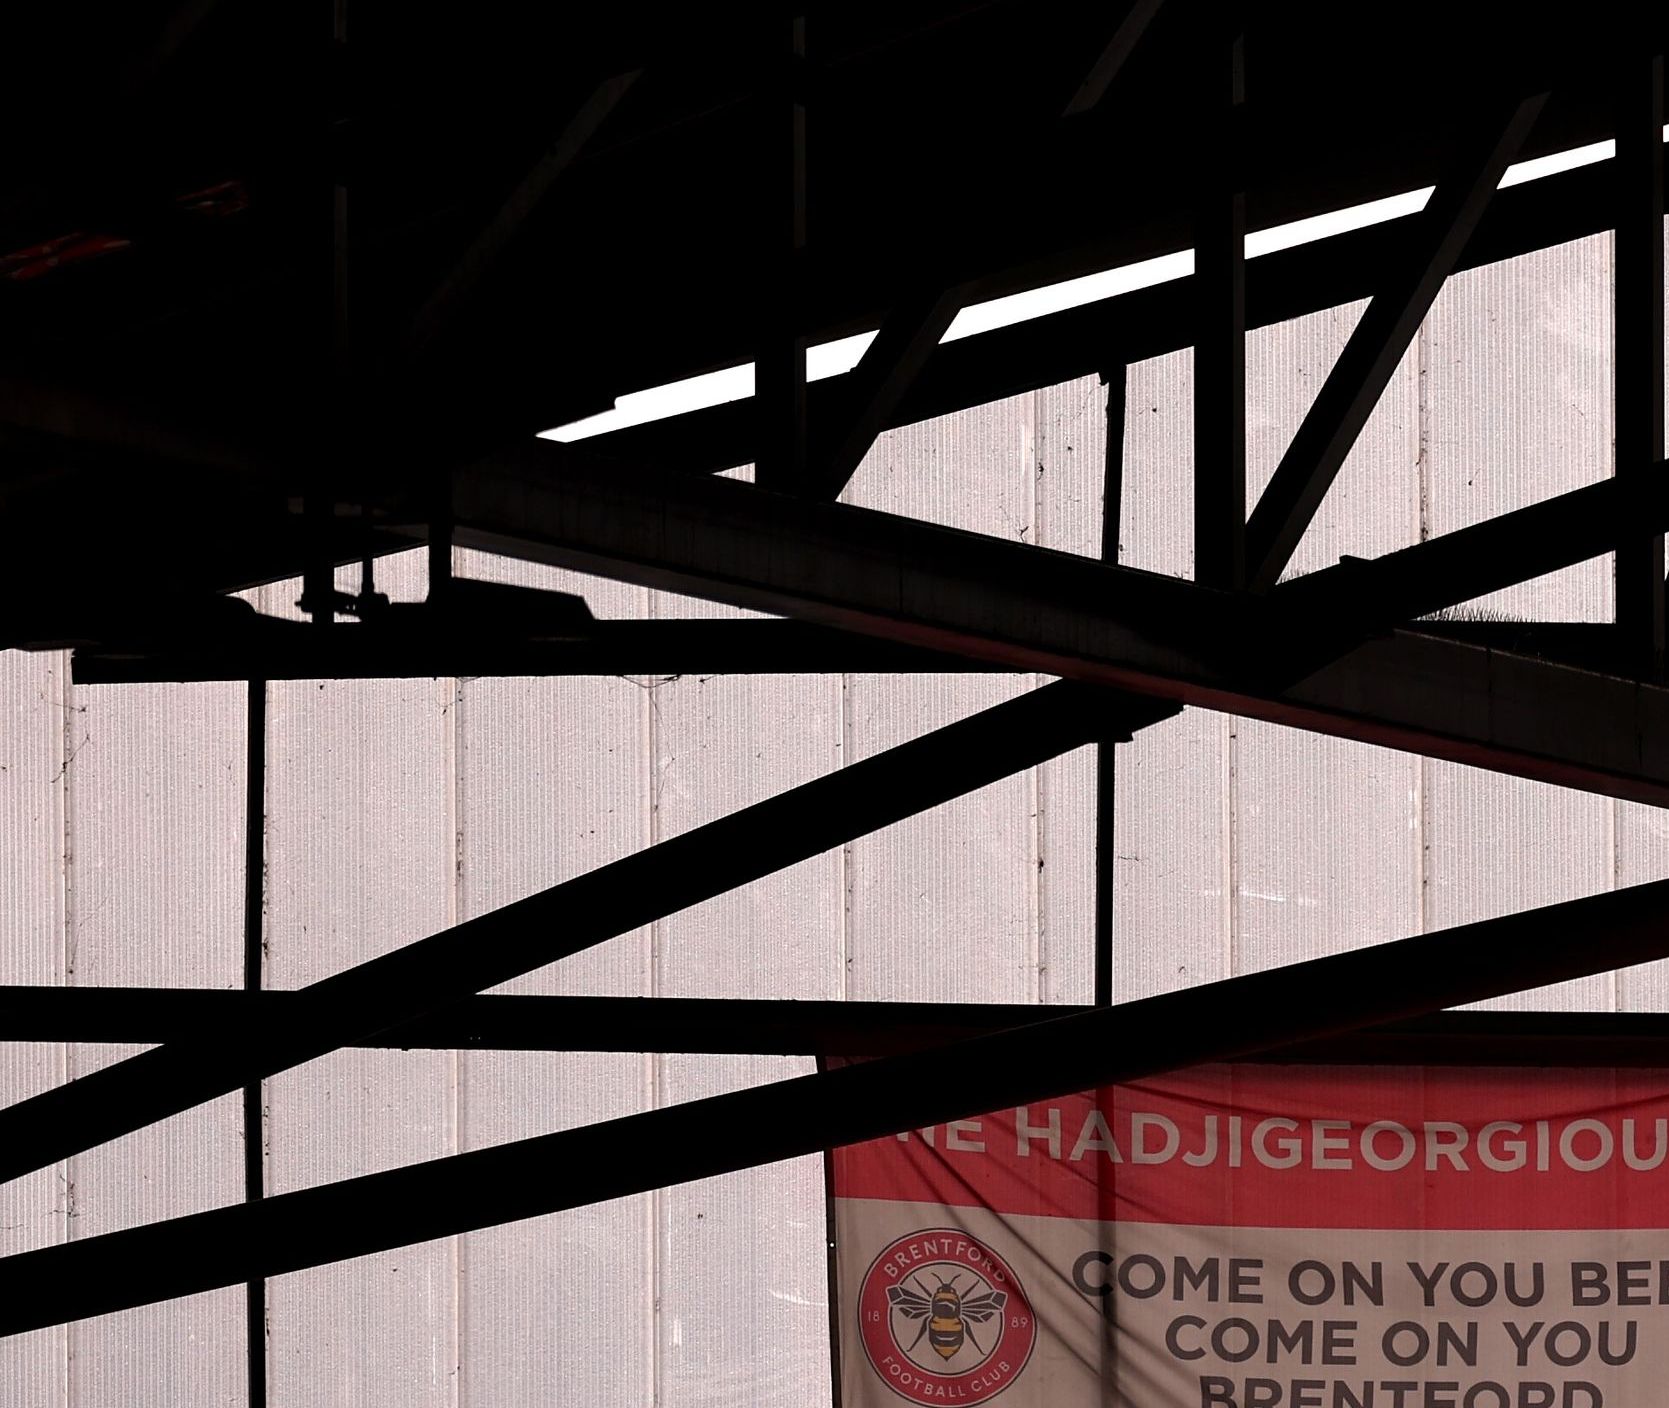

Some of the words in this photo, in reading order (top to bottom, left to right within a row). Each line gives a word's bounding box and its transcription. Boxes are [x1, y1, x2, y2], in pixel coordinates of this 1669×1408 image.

[1015, 1106, 1669, 1172] HADJIGEORGIOU
[884, 1238, 1006, 1283] BRENTFORD
[1072, 1250, 1263, 1308] COME
[1288, 1259, 1384, 1308] ON
[1405, 1260, 1547, 1308] YOU
[867, 1310, 880, 1322] 18
[1011, 1316, 1028, 1329] 89
[1164, 1314, 1357, 1365] COME
[1382, 1319, 1479, 1368] ON
[1499, 1320, 1639, 1368] YOU
[882, 1356, 967, 1398] FOOTBALL
[970, 1361, 1010, 1392] CLUB
